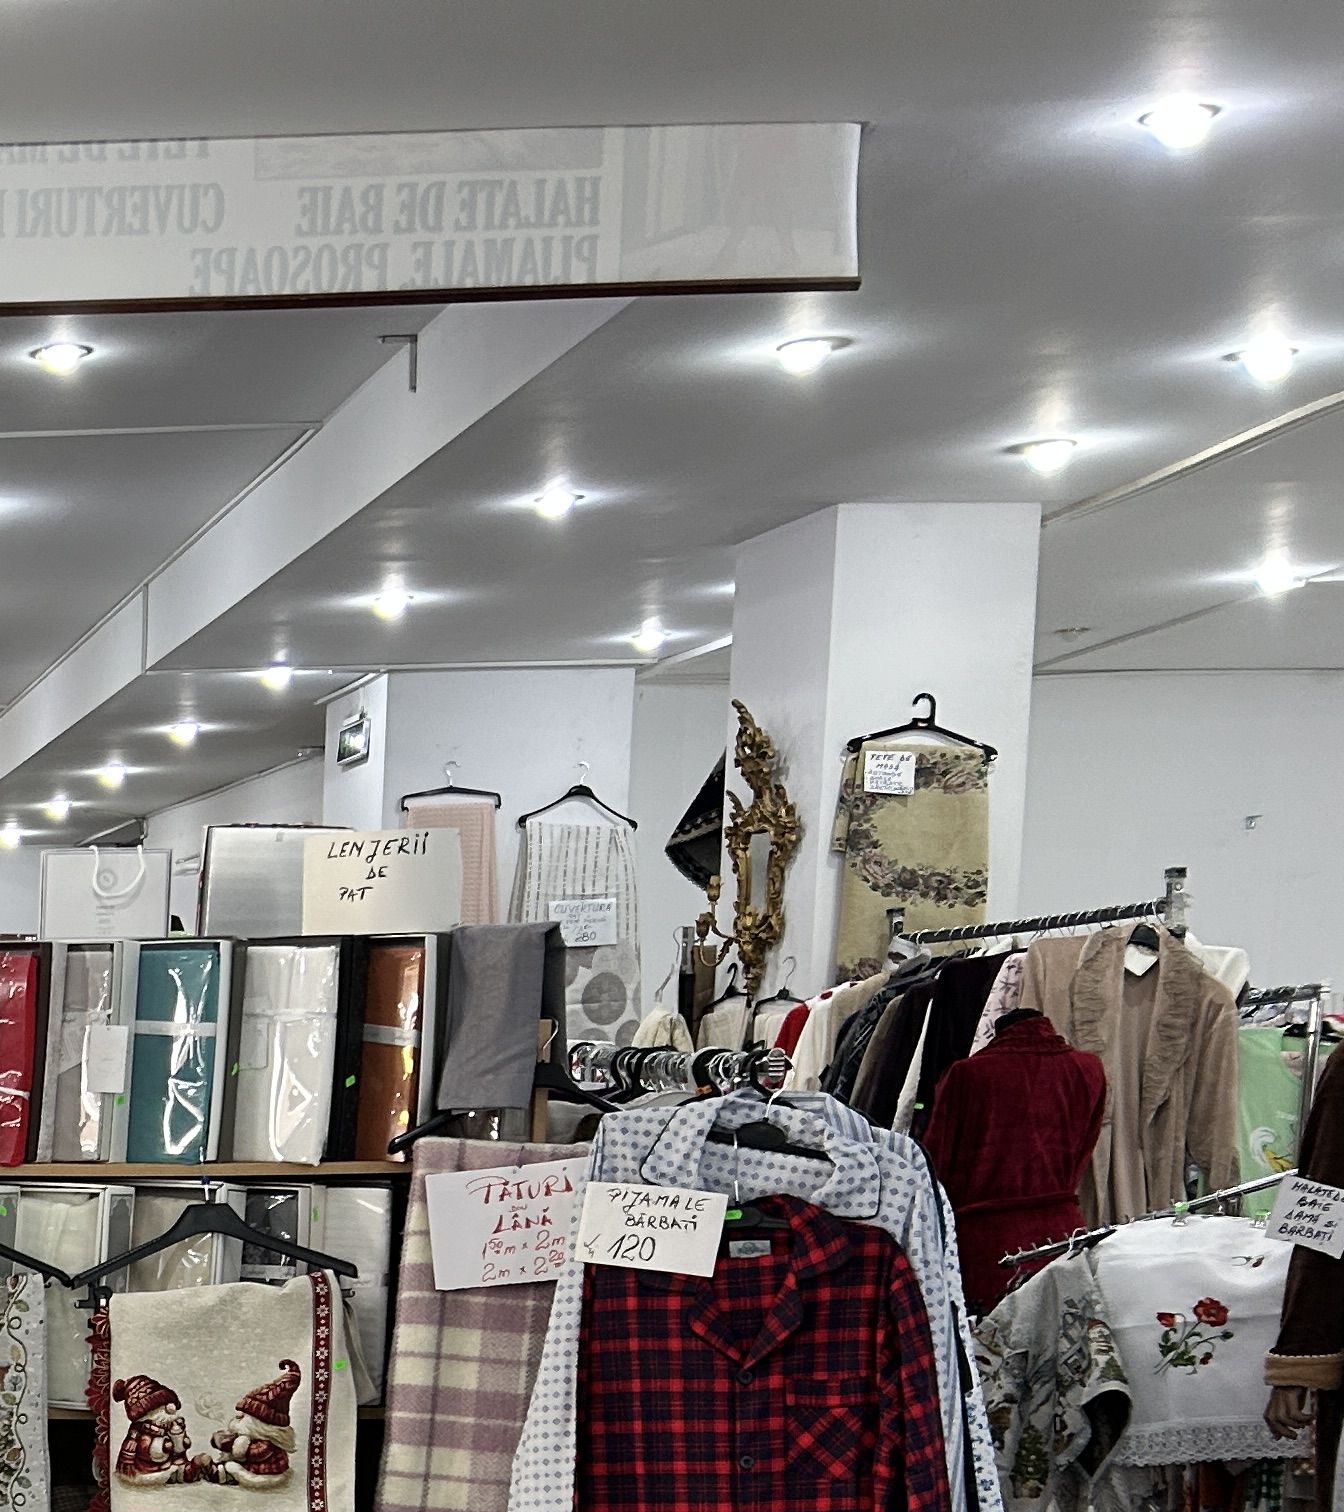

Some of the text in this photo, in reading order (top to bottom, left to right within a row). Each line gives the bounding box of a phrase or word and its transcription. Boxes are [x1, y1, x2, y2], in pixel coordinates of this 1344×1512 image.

[327, 831, 430, 863] LENJERII
[365, 866, 388, 880] DE
[339, 887, 374, 901] PAT
[607, 1187, 711, 1214] PIJAMALE
[607, 1233, 656, 1261] 120
